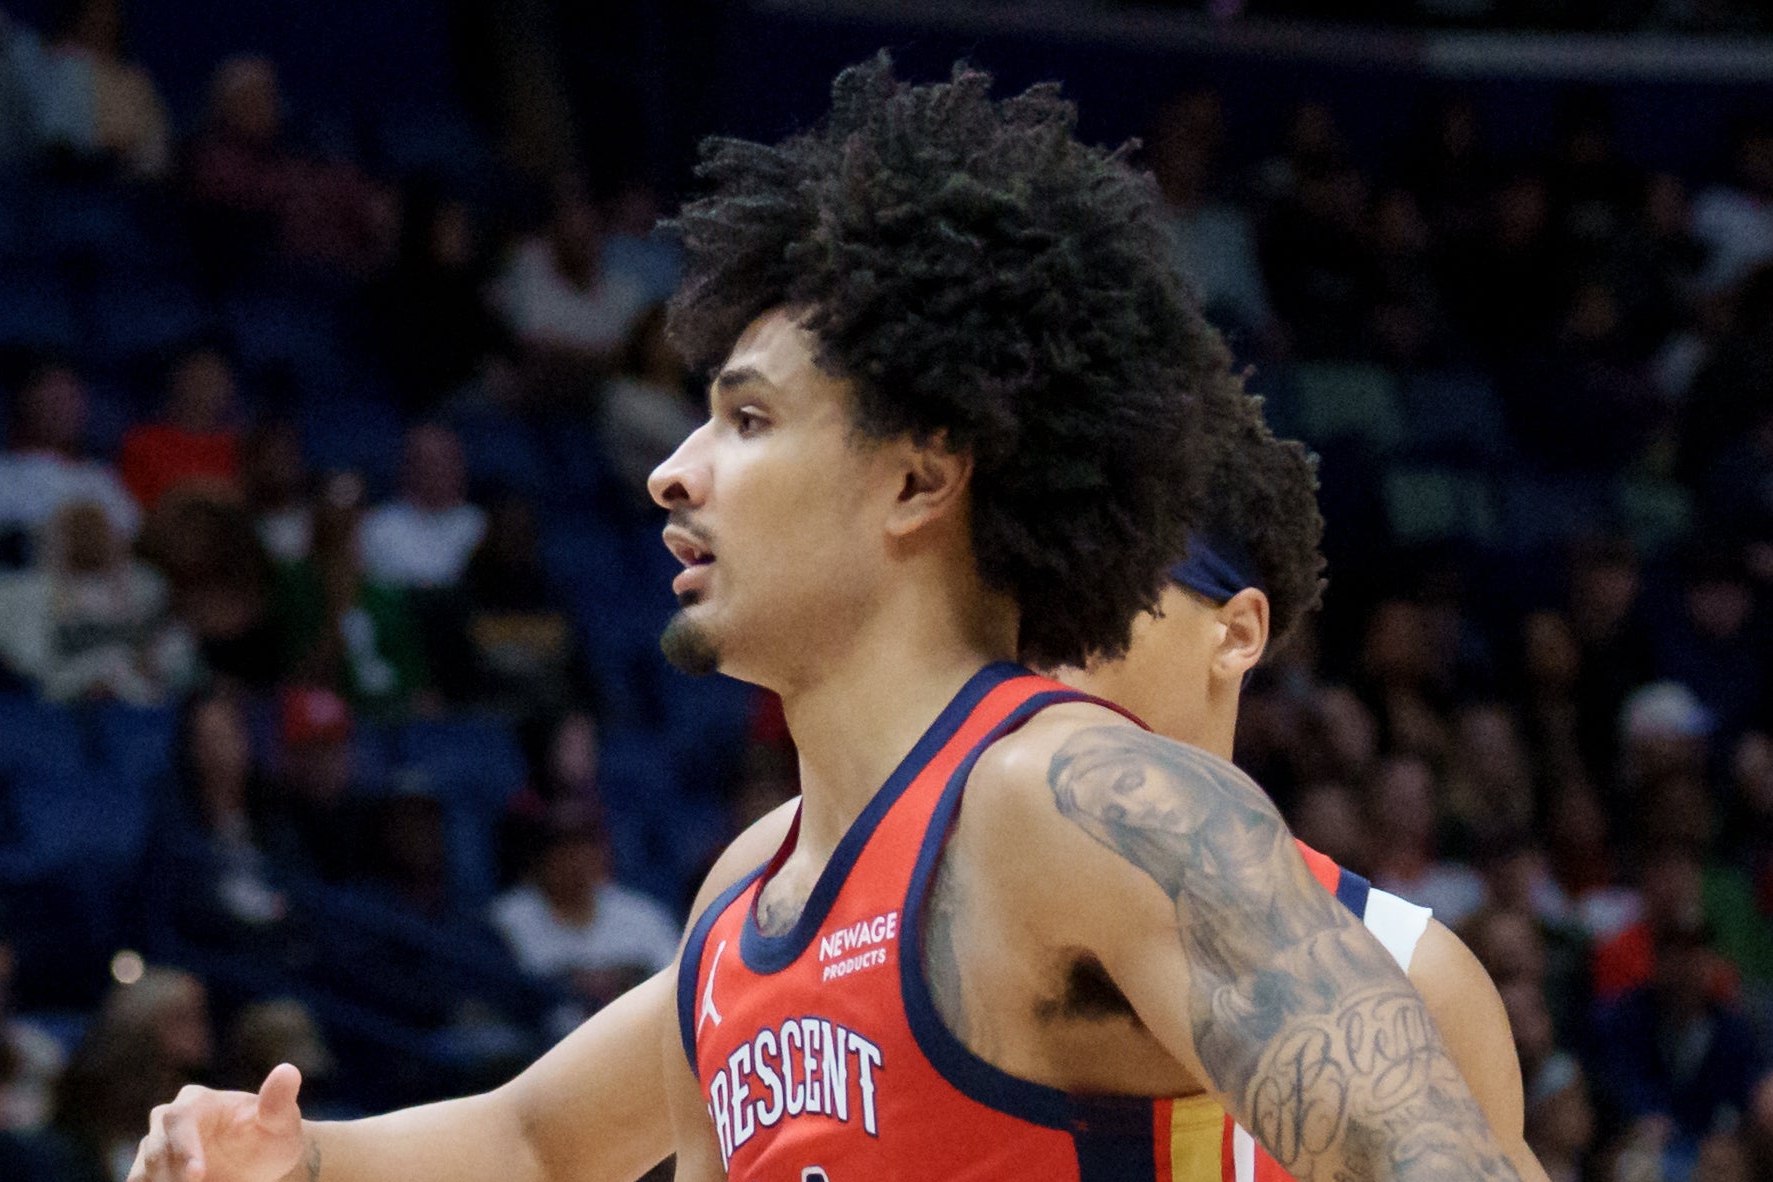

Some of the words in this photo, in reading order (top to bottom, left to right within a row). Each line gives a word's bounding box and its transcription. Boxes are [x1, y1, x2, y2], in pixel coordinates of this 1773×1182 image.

[819, 911, 898, 962] NEWAGE
[823, 948, 887, 982] PRODUCTS
[707, 1016, 884, 1174] RESCENT
